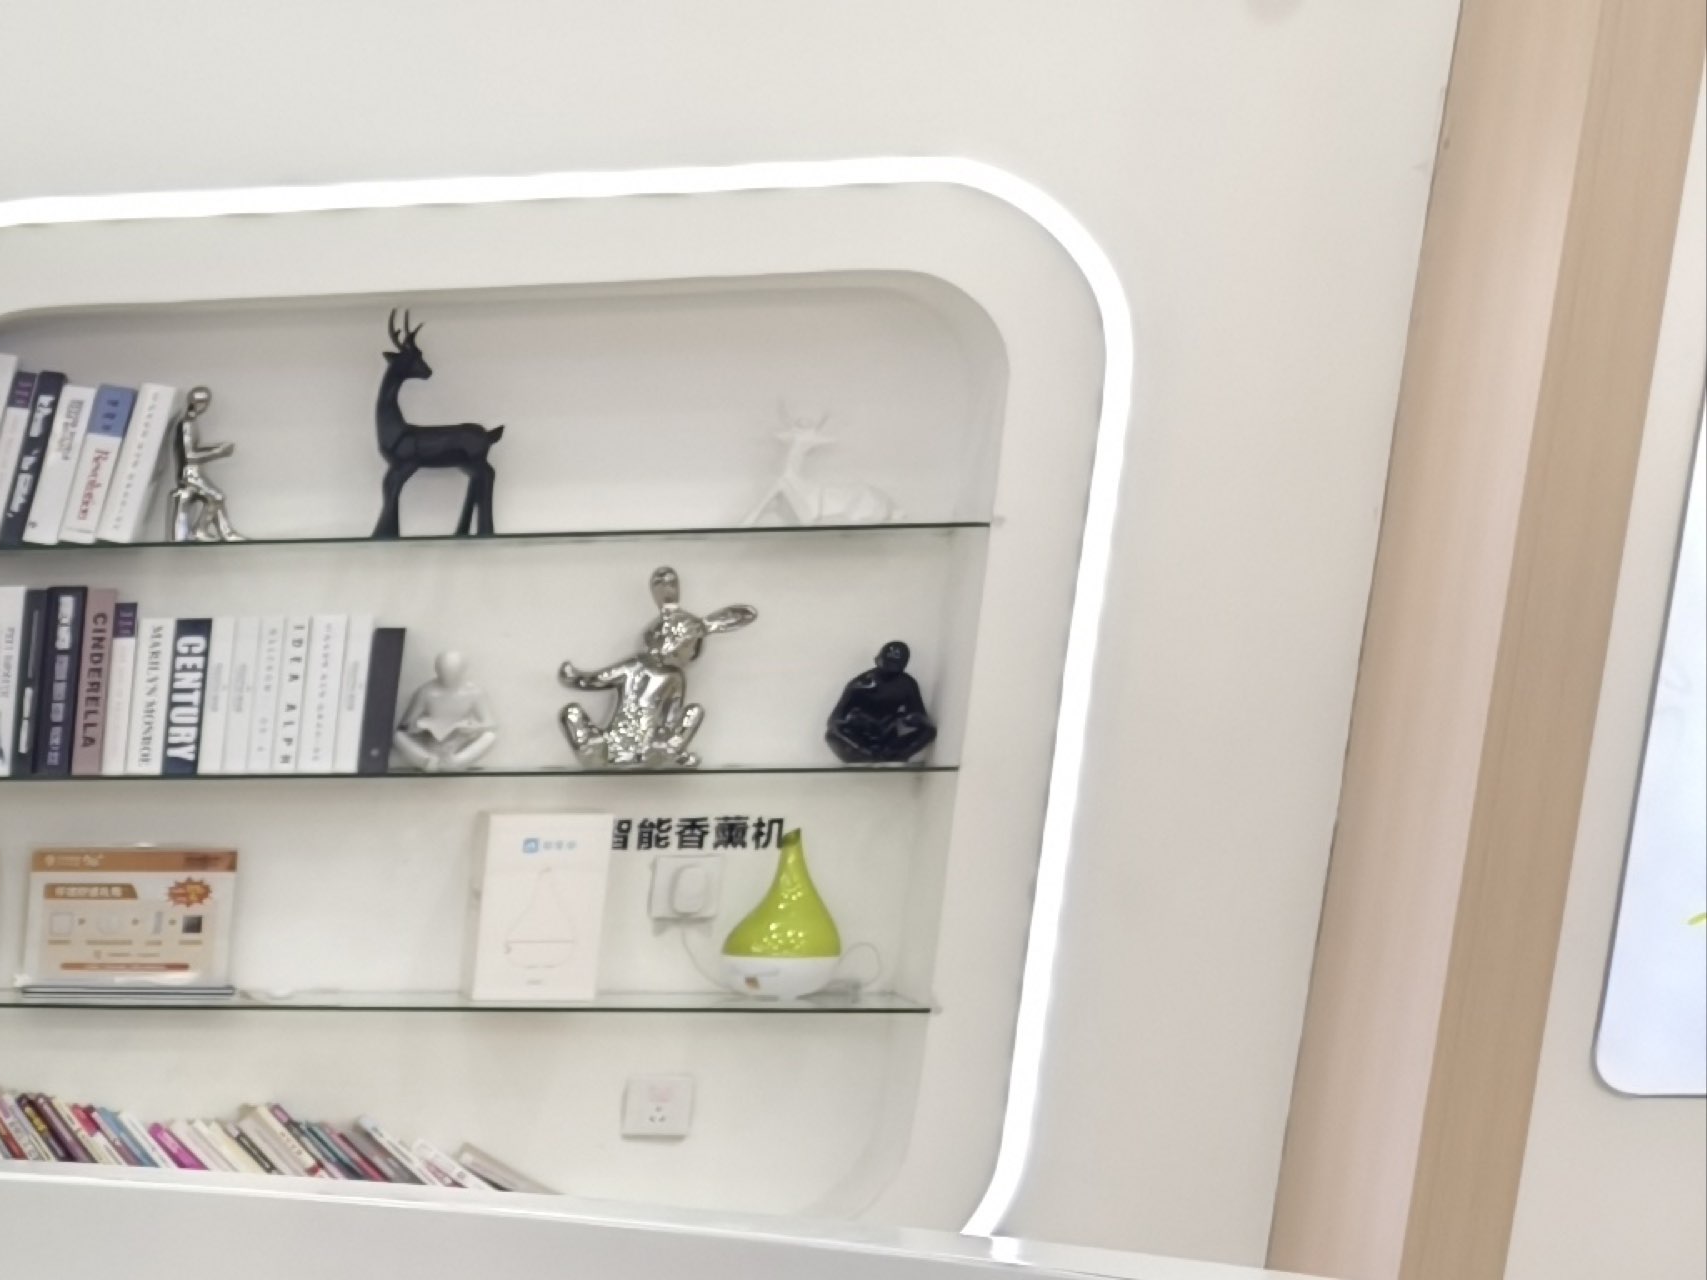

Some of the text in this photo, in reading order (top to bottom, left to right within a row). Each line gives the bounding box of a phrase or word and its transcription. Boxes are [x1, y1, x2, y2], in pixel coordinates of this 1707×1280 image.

[81, 612, 108, 749] CINDERELLA
[145, 624, 165, 696] MARILYN
[167, 635, 208, 762] CENTURY
